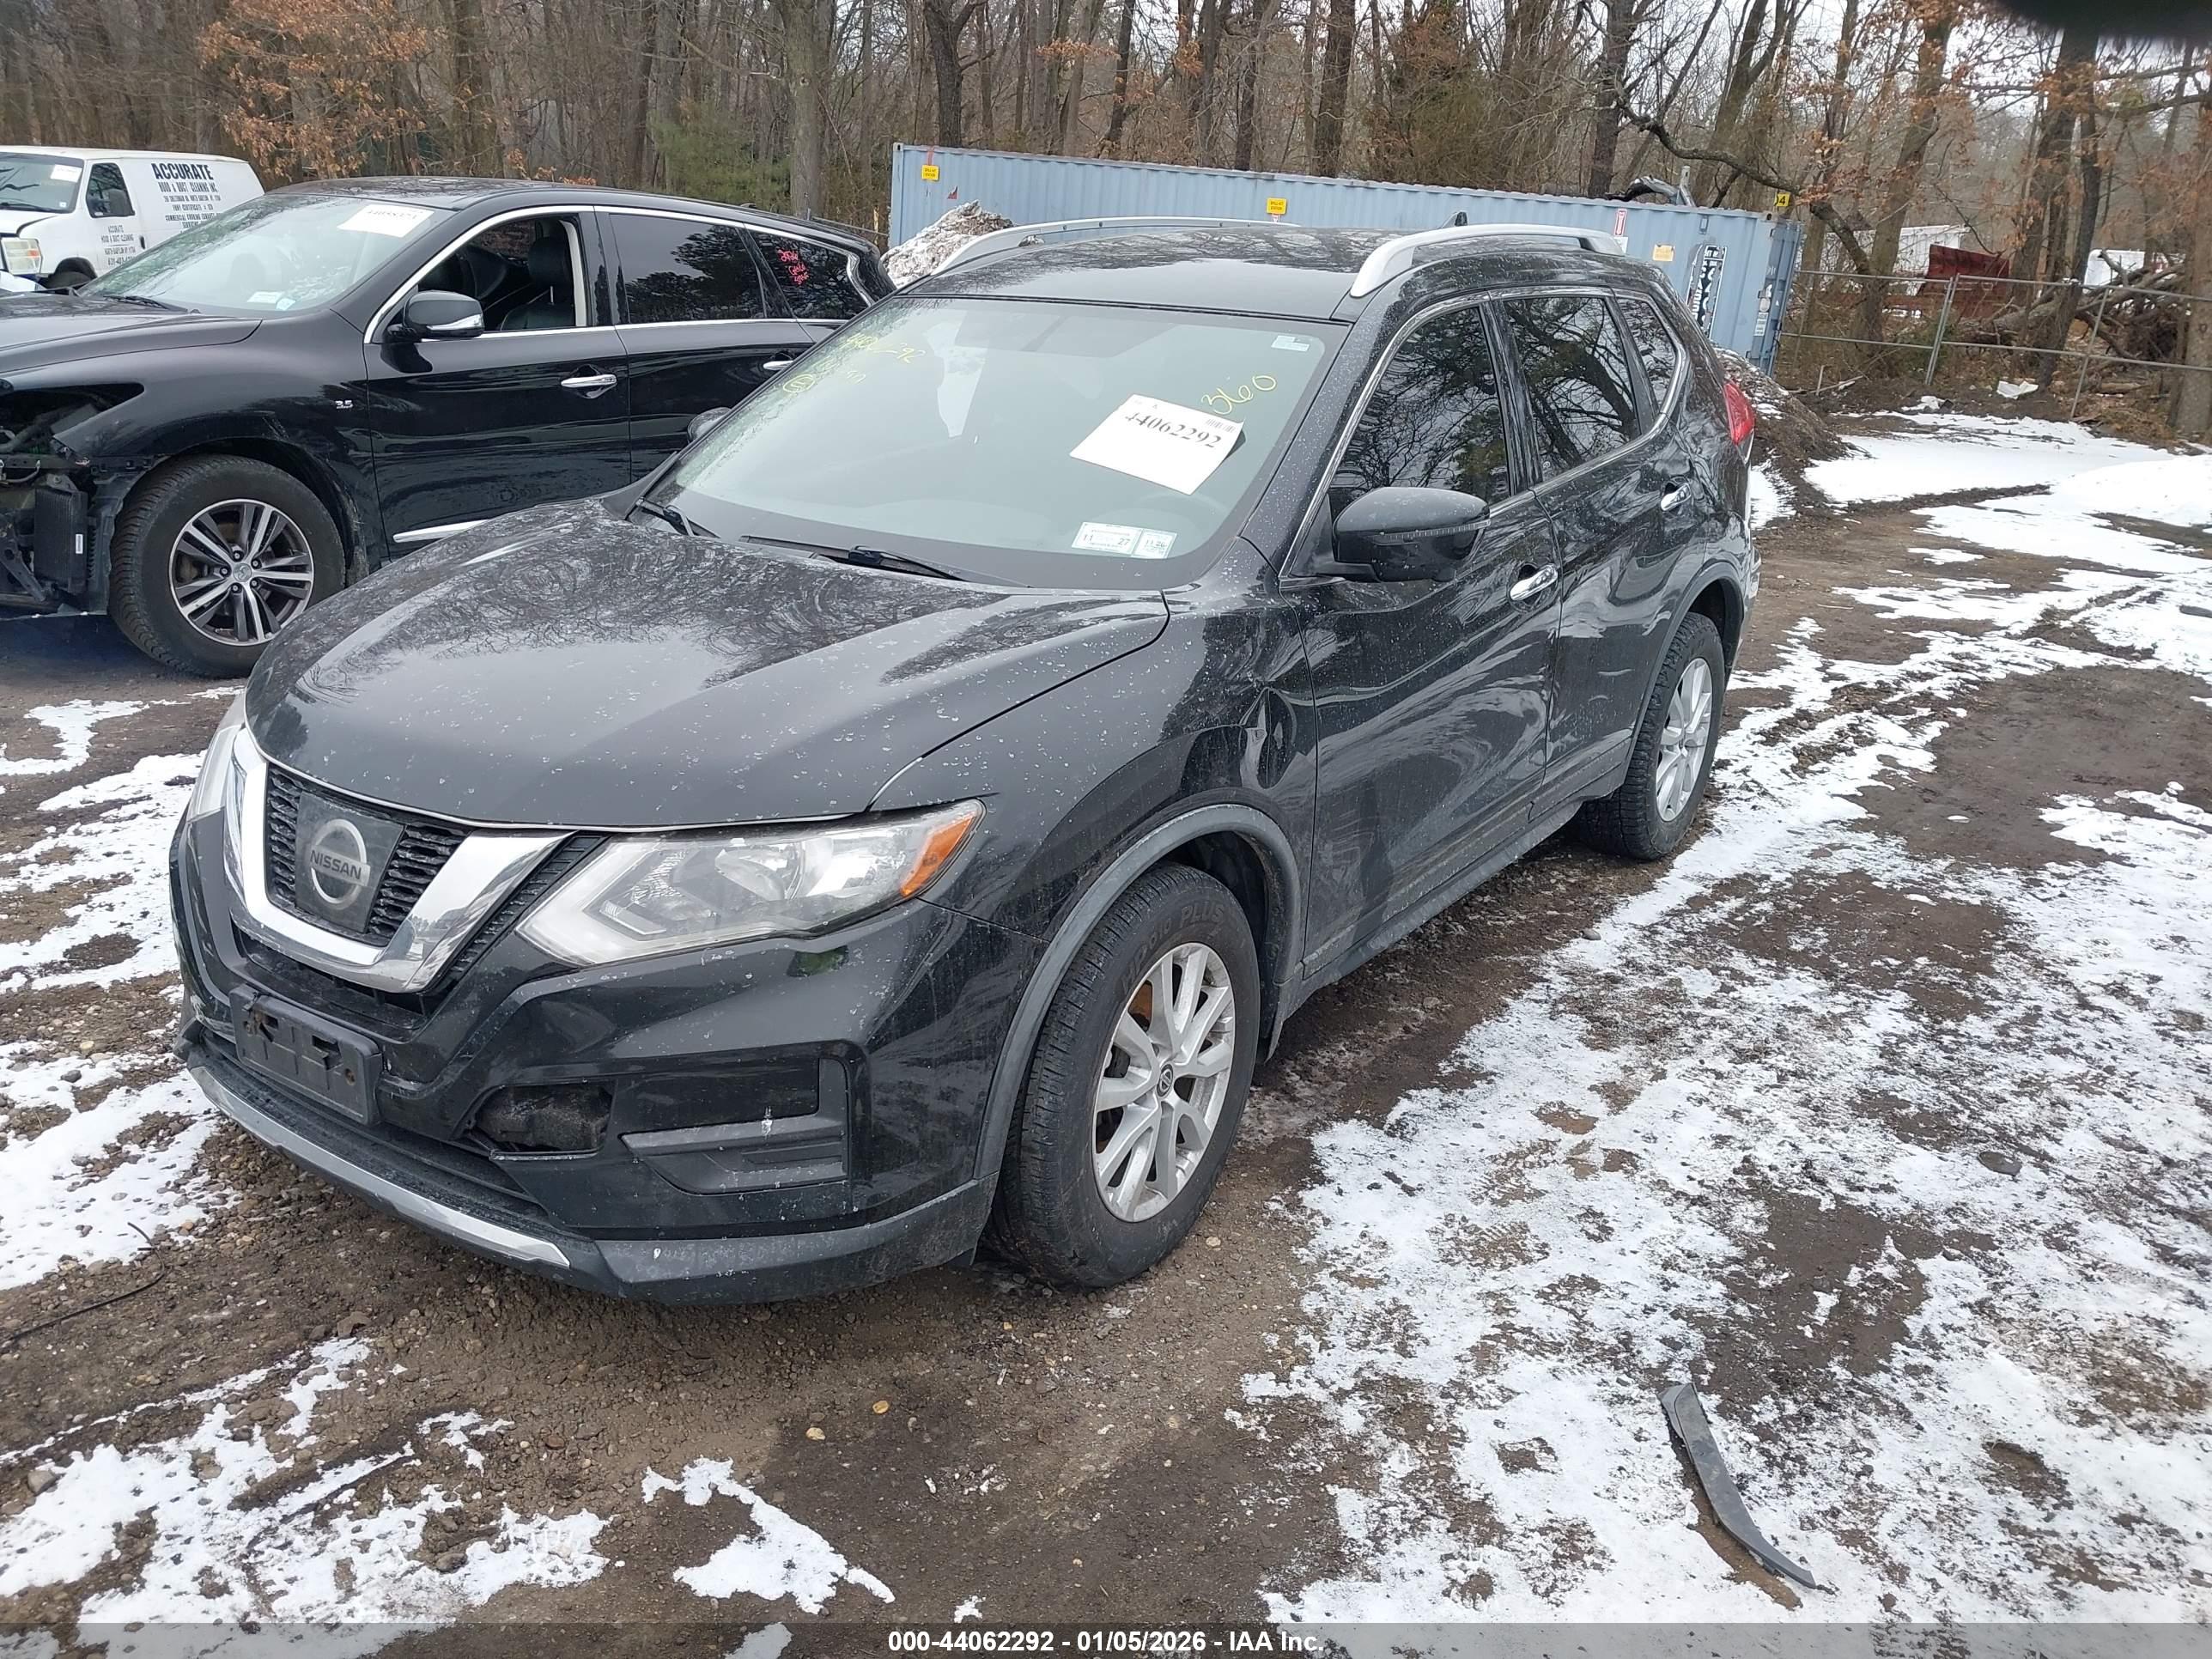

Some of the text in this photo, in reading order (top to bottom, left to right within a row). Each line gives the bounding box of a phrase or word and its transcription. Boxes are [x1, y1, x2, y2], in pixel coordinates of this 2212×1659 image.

[151, 162, 214, 180] ACCURATE
[189, 181, 210, 192] CLEANING
[1200, 374, 1278, 415] 360
[1117, 538, 1131, 546] 27
[310, 849, 362, 880] NISSAN
